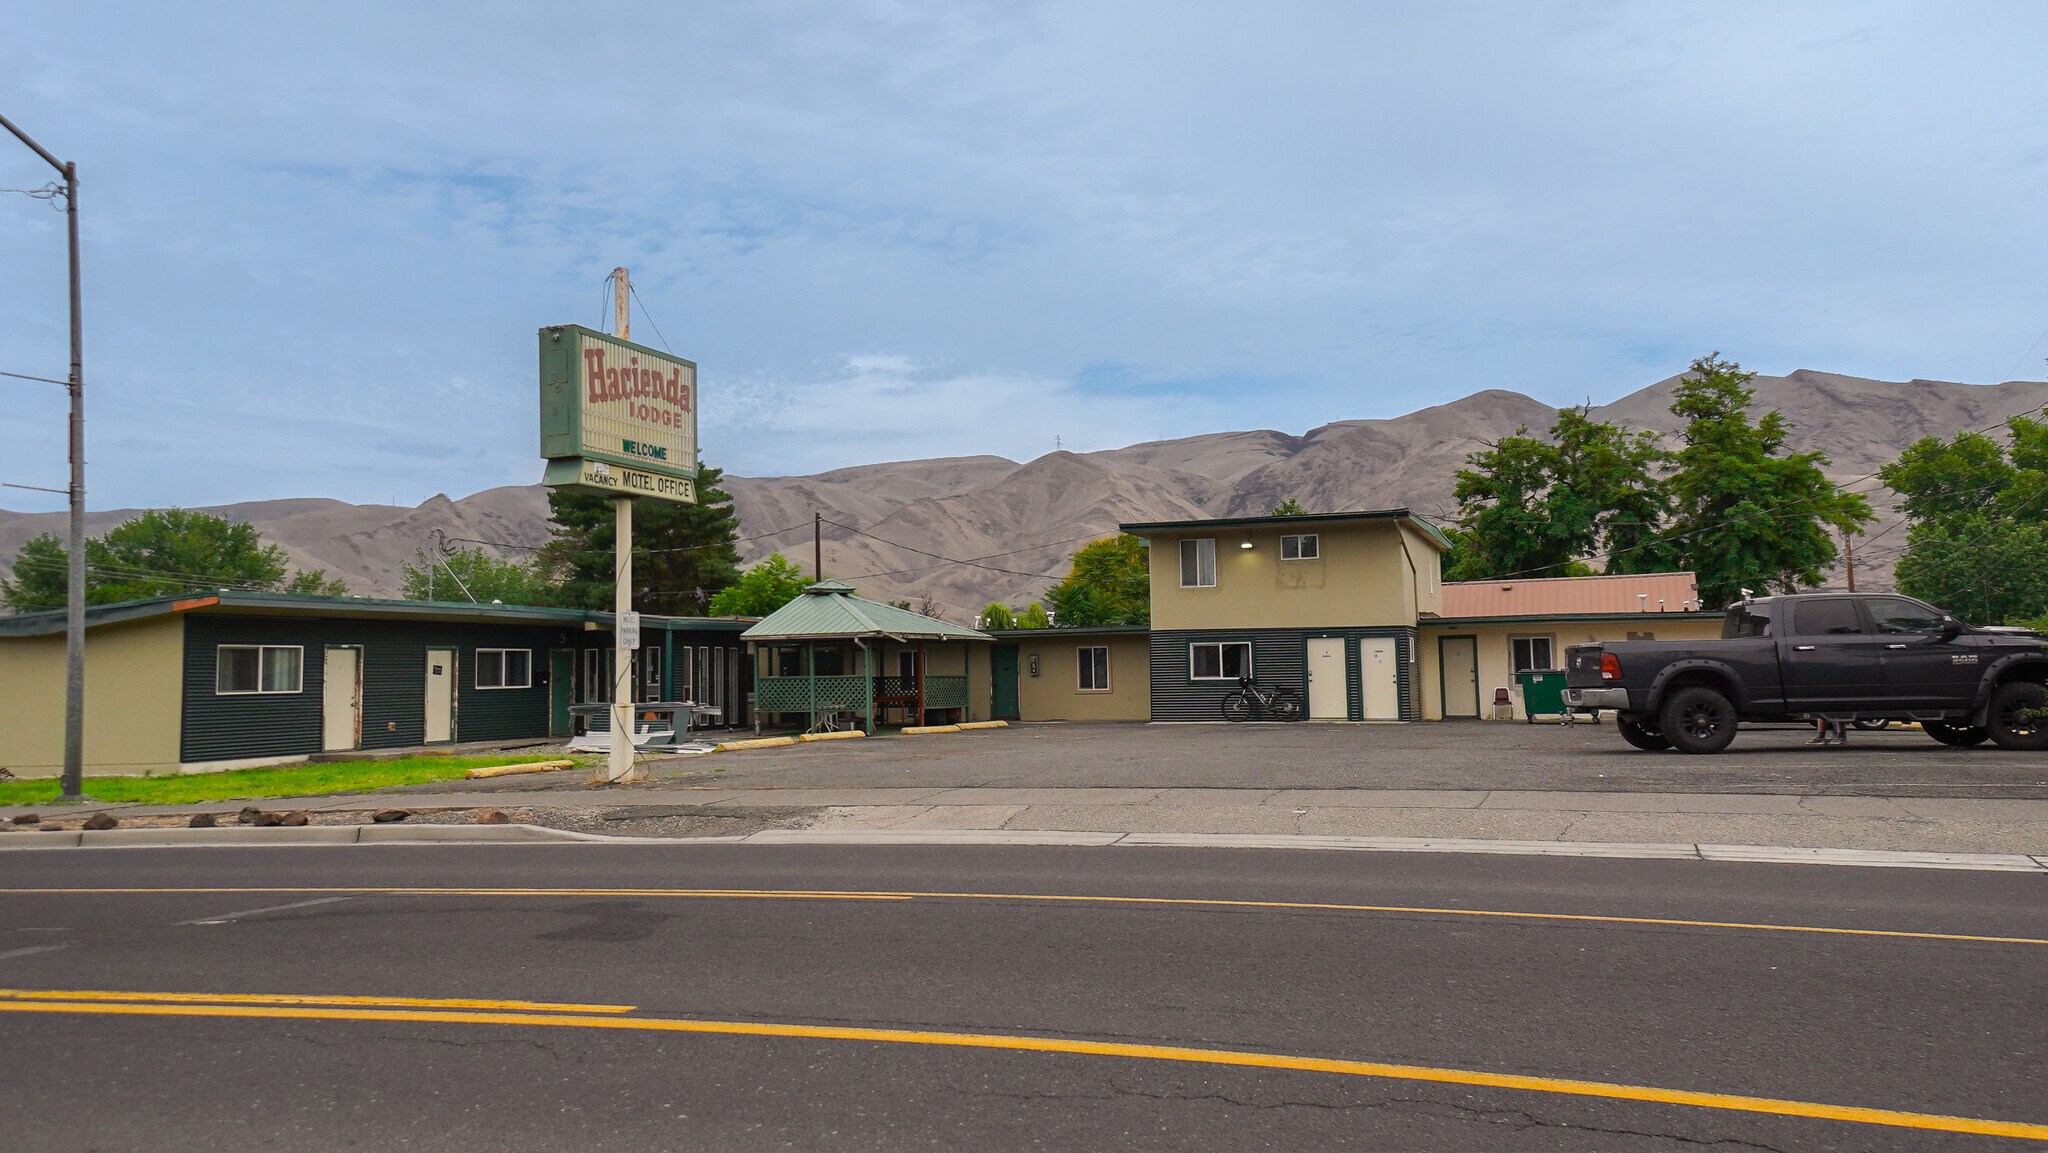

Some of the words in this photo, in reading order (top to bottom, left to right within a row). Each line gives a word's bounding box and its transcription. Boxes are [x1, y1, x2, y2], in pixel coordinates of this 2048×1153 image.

[584, 348, 691, 413] Hacienda
[630, 401, 682, 429] LODGE
[622, 439, 667, 461] WELCOME
[584, 472, 618, 487] VACANCY
[622, 470, 655, 491] MOTEL
[658, 478, 690, 497] OFFICE
[623, 637, 636, 645] ONLY
